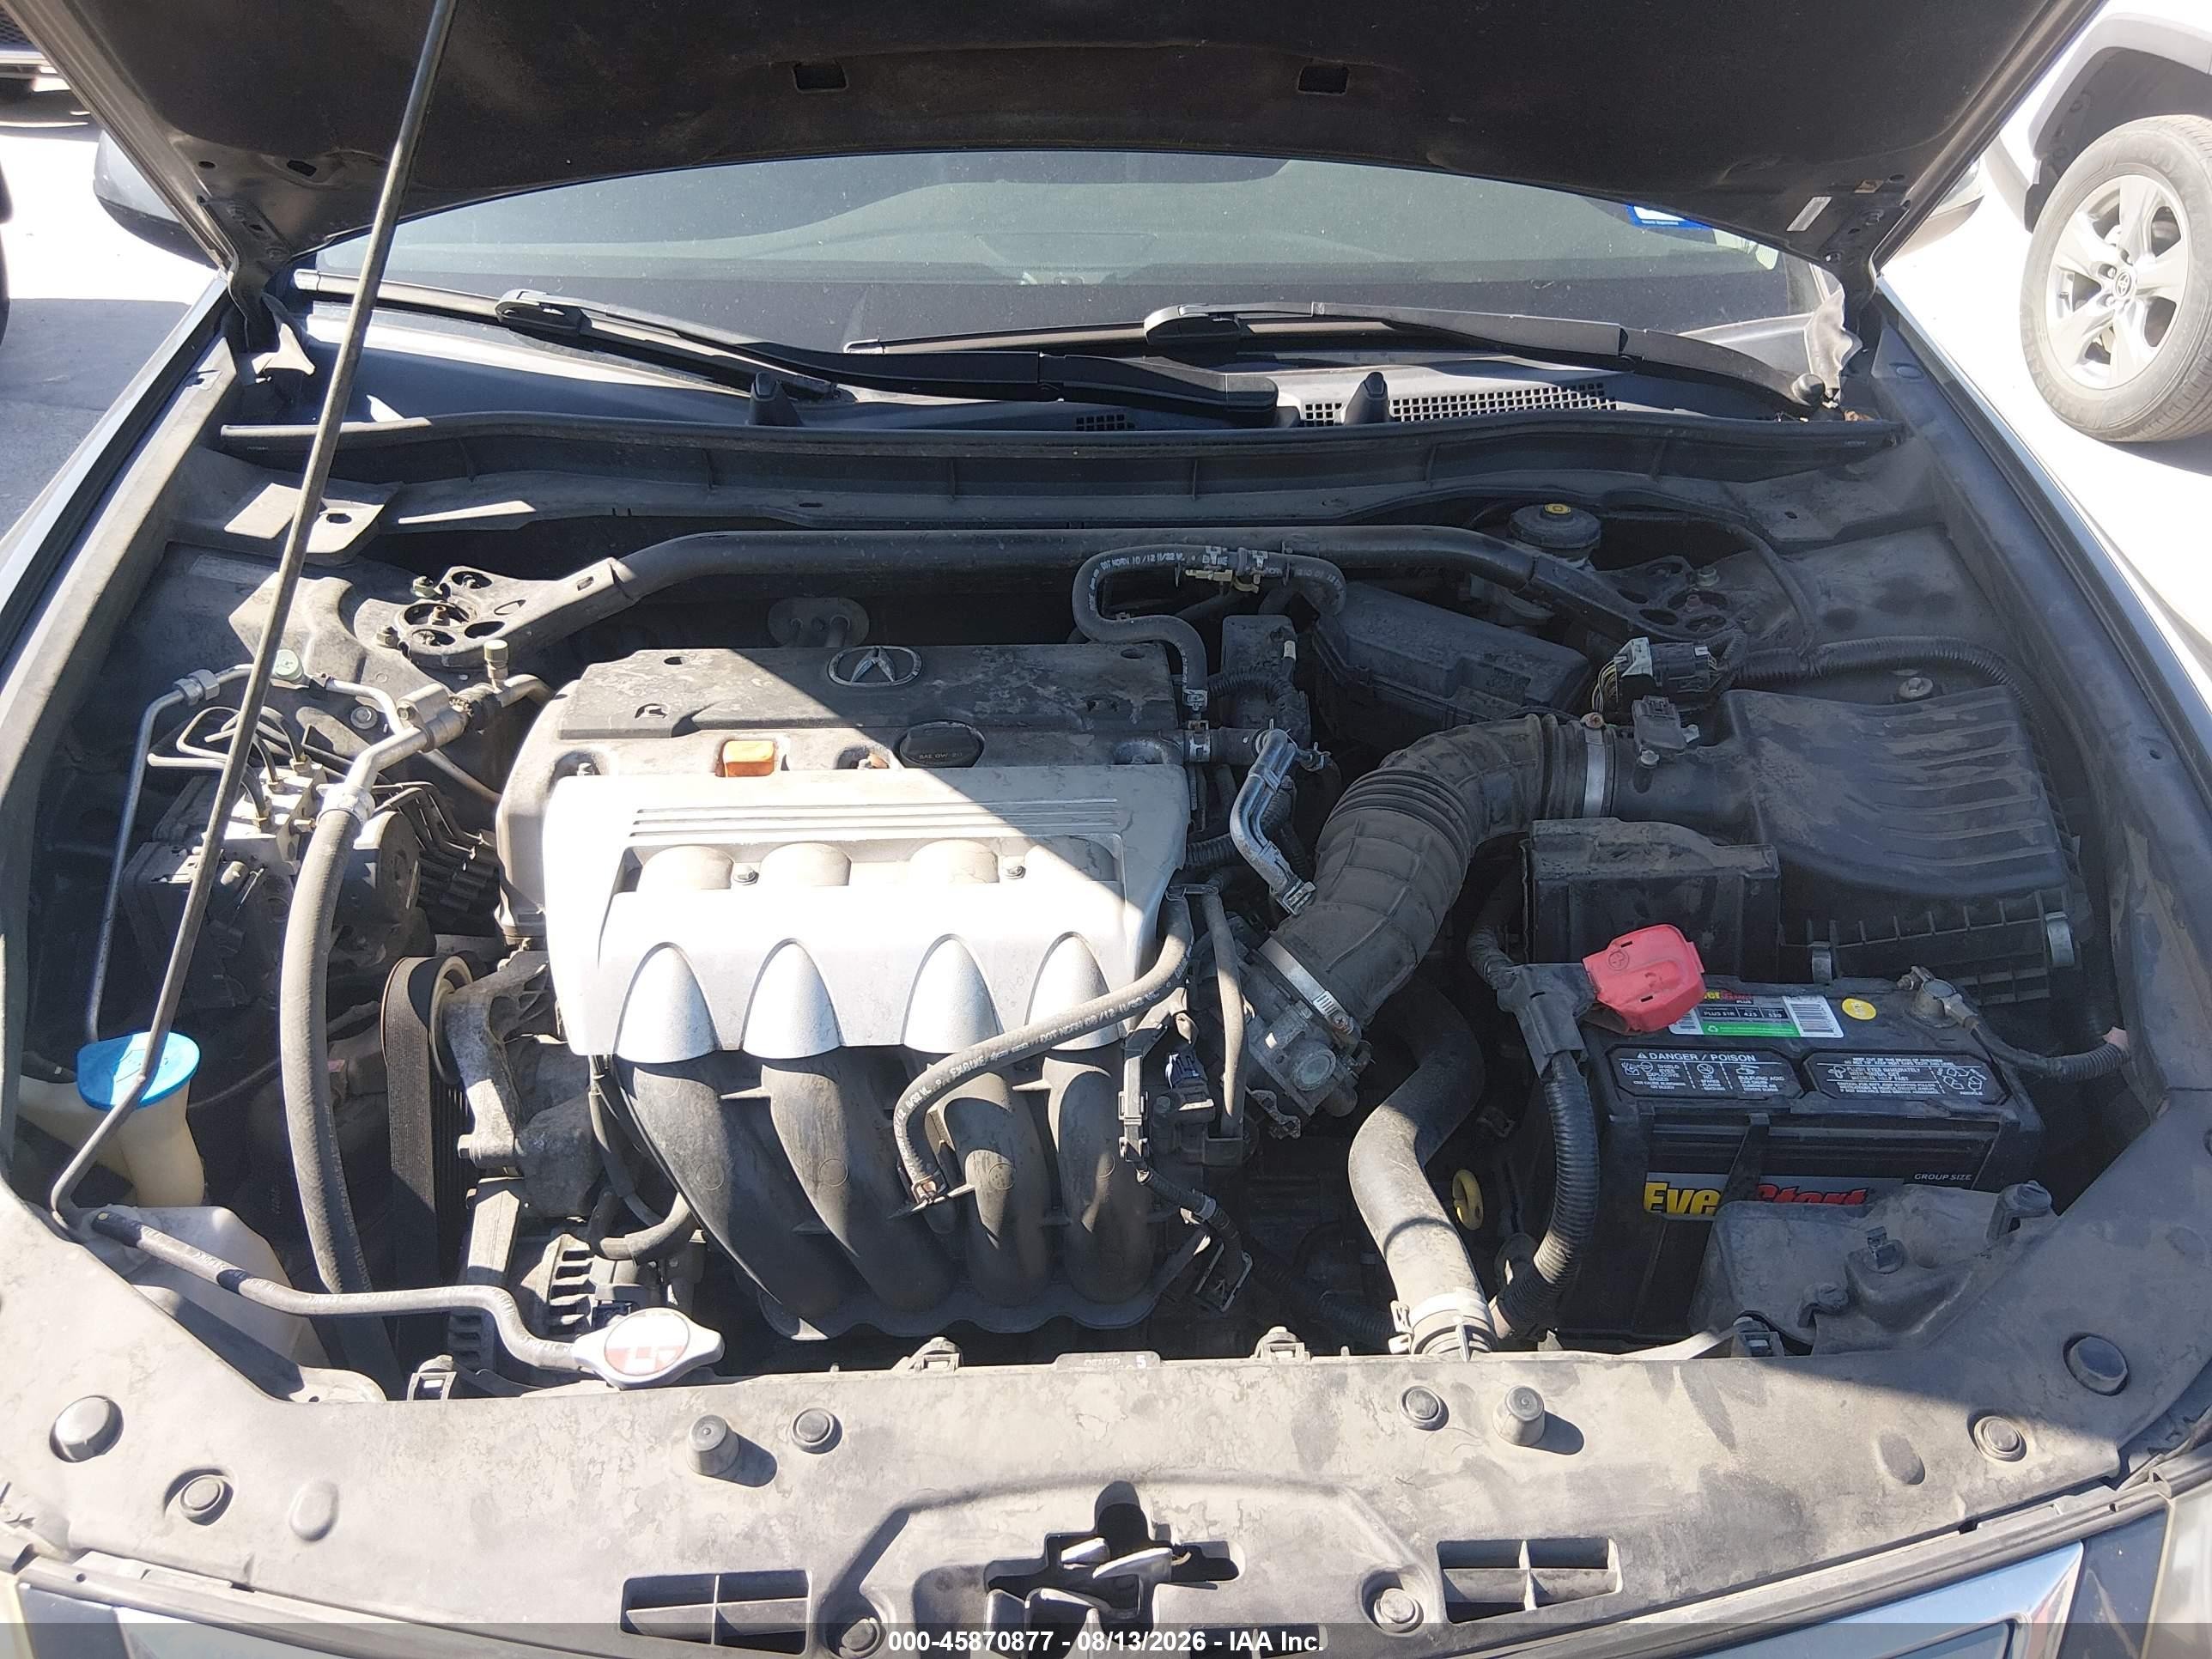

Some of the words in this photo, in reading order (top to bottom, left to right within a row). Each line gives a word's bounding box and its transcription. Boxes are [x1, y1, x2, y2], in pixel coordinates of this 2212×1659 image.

[1710, 1054, 1757, 1062] POISON
[1914, 1173, 1949, 1182] GROUP
[1949, 1173, 1972, 1182] SIZE
[1135, 1354, 1147, 1369] 5
